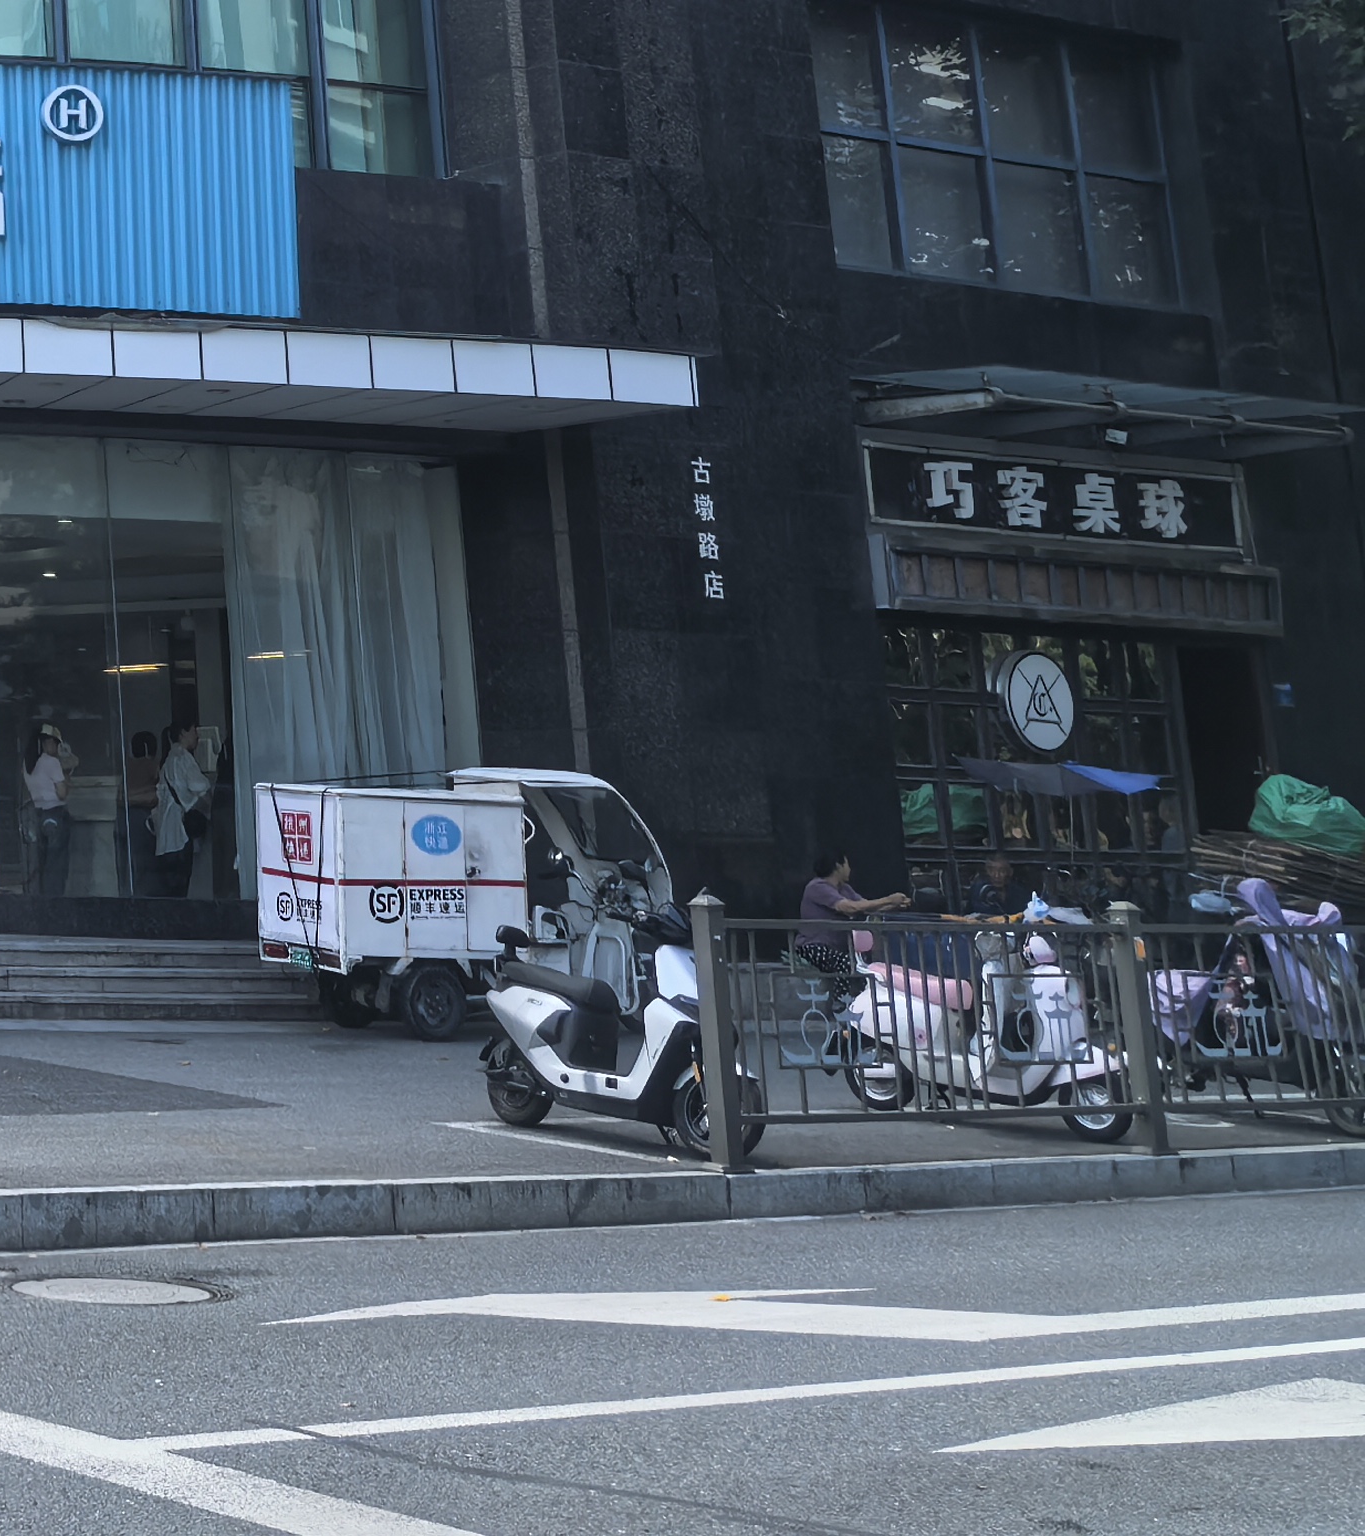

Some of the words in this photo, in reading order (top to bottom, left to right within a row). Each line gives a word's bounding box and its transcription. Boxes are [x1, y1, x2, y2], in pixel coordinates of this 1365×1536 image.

[923, 460, 1188, 538] 巧客桌球
[690, 456, 725, 600] 古墩路店
[279, 899, 291, 915] SF
[376, 893, 398, 913] SF
[409, 888, 465, 902] EXPRESS
